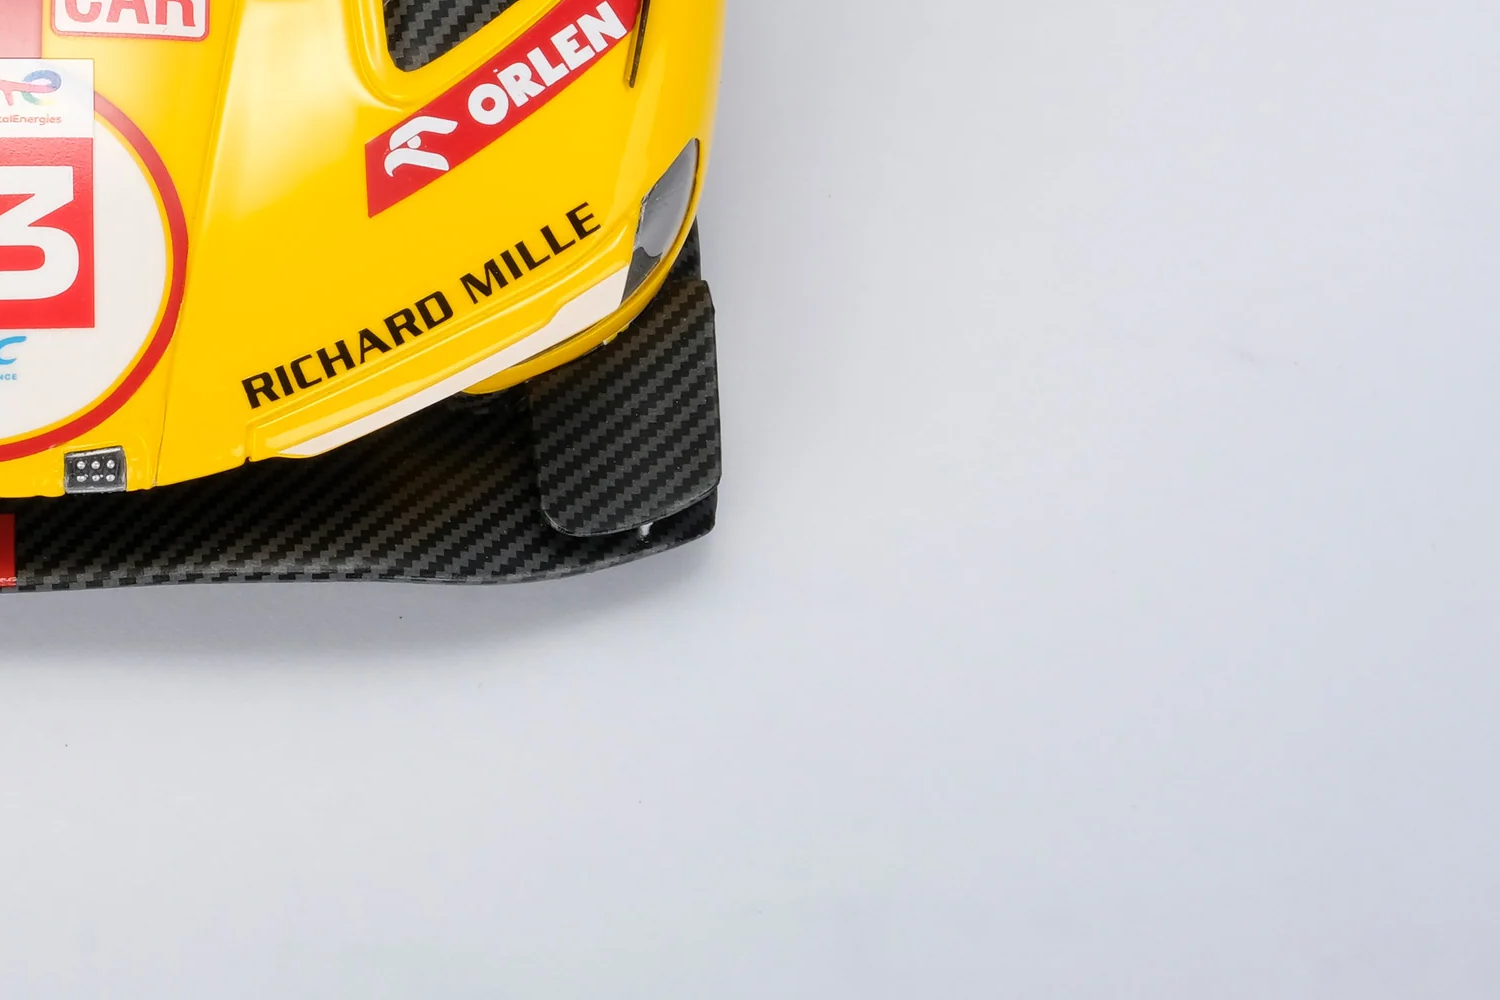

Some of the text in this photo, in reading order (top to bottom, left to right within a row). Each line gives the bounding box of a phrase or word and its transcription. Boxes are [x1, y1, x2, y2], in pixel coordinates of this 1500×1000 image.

[467, 0, 627, 126] ORLEN
[241, 201, 601, 409] RICHARD MILLE
